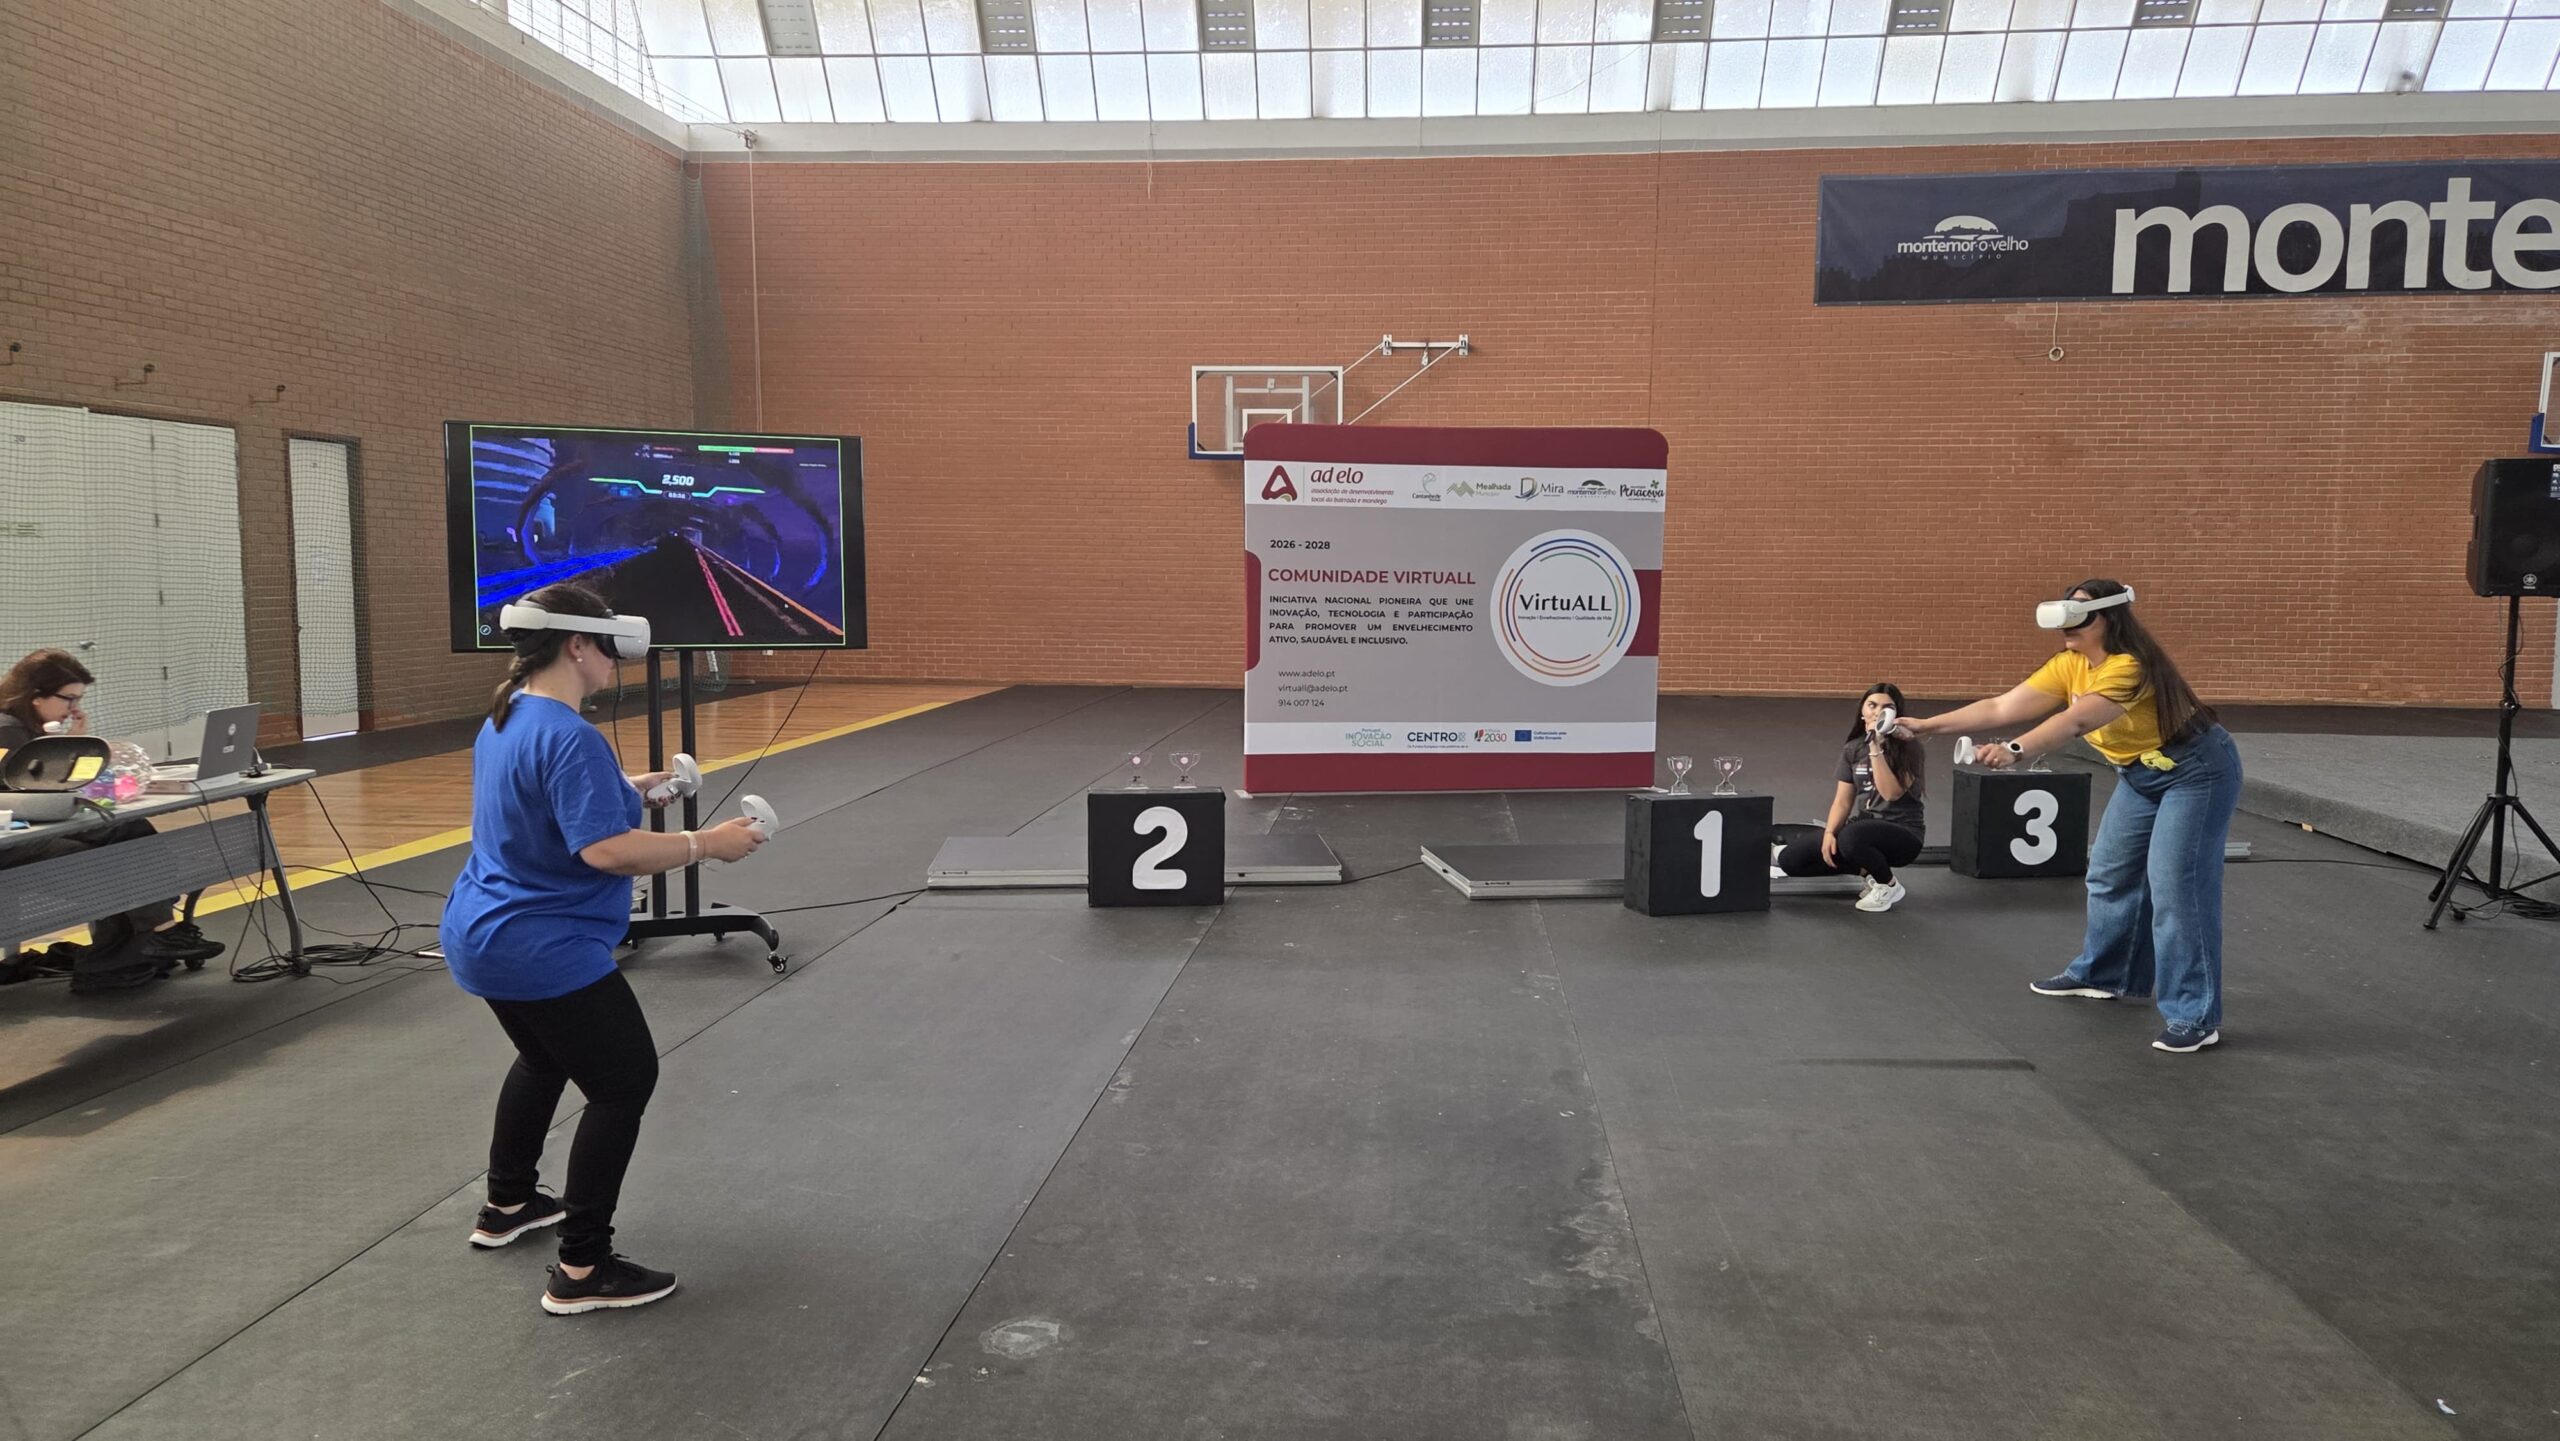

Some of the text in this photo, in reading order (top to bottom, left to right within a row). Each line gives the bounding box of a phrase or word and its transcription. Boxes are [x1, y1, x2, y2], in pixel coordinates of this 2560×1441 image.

[2111, 177, 2560, 294] monte
[661, 474, 695, 486] 2,500
[1310, 467, 1364, 484] ad elo
[1476, 482, 1511, 490] Mealhada
[1540, 483, 1564, 493] Mira
[1620, 484, 1664, 498] Penacova
[1270, 540, 1296, 549] 2026
[1305, 541, 1330, 549] 2028
[1268, 568, 1476, 584] COMUNIDADE VIRTUALL
[1270, 596, 1474, 606] INICIATIVA NACIONAL PIONEIRA QUE UNE
[1519, 593, 1613, 611] VirtuALL
[1269, 608, 1474, 620] INOVAÇÃO, TECNOLOGIA E PARTICIPAÇÃO
[1269, 622, 1294, 630] PARA
[1305, 623, 1357, 631] PROMOVER
[1392, 624, 1474, 632] ENVELHECIMENTO
[1269, 636, 1299, 645] ATIVO,
[1301, 634, 1349, 644] SAUDÁVEL
[1358, 637, 1408, 645] INCLUSIVO.
[1407, 732, 1458, 742] CENTRO
[1484, 733, 1507, 742] 2030
[2009, 789, 2059, 865] 3
[1132, 805, 1189, 890] 2
[1693, 810, 1723, 898] 1
